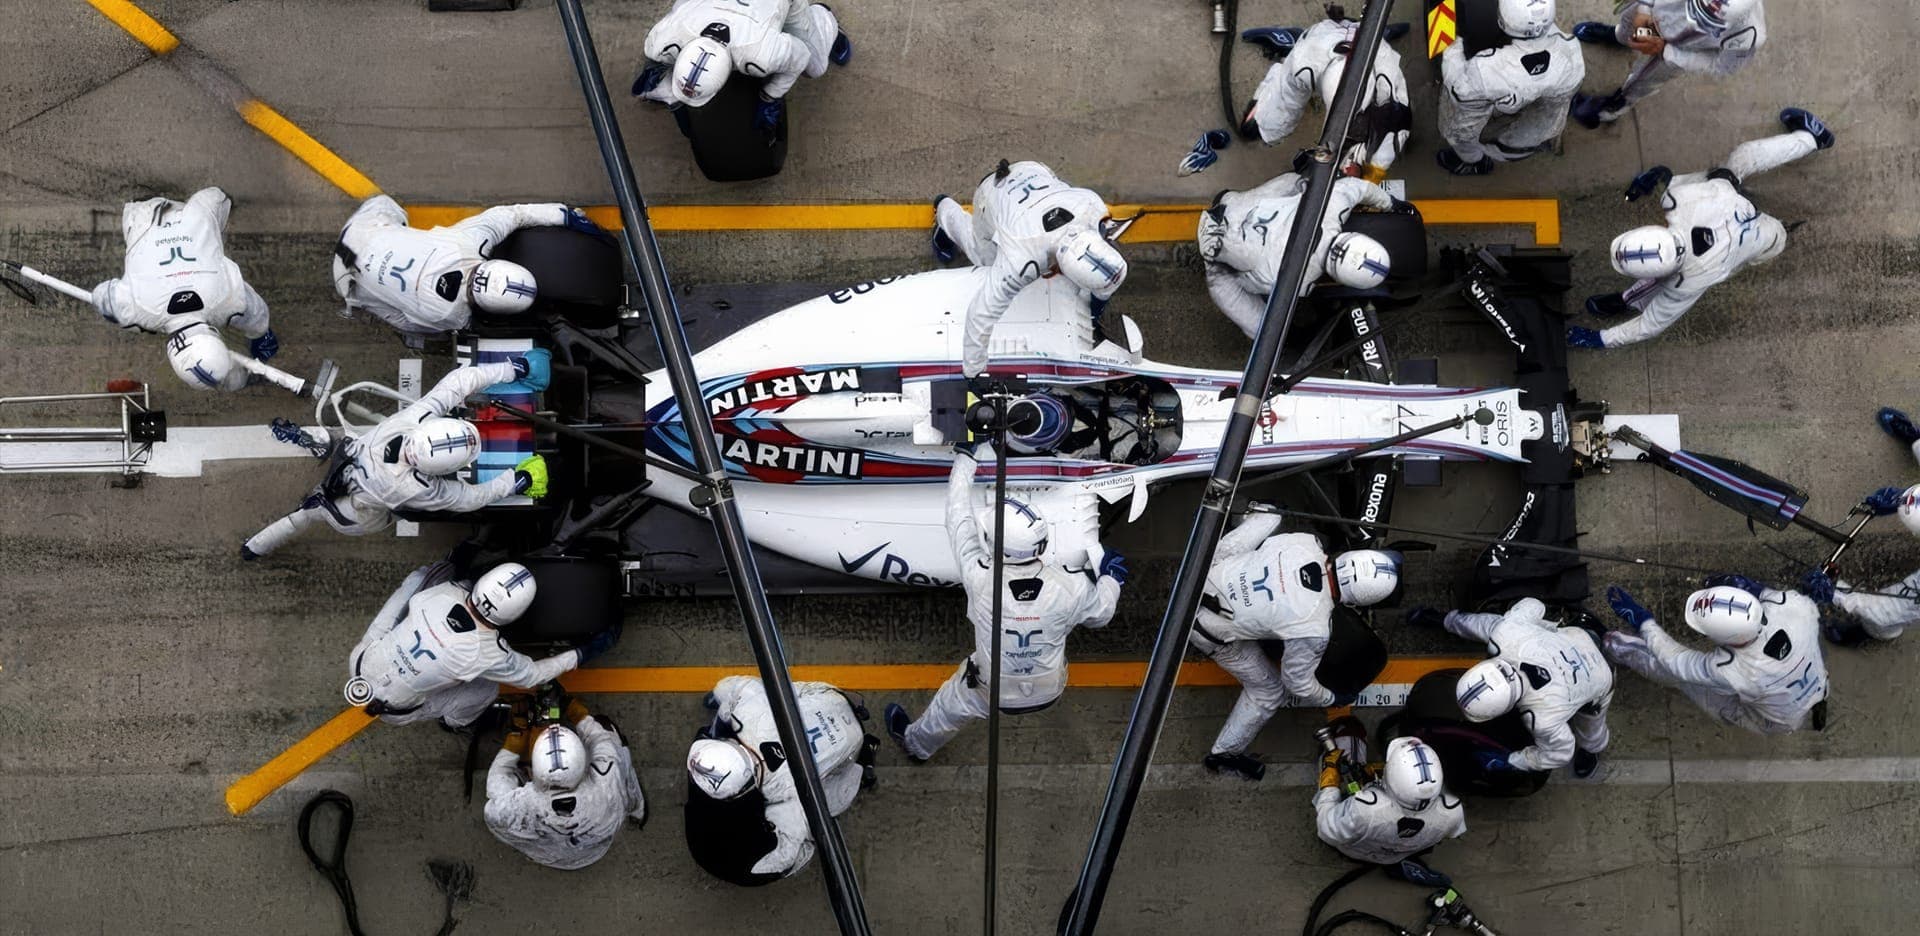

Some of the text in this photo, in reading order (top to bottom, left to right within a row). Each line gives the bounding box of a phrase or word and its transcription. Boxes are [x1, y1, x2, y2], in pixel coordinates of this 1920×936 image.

[1351, 306, 1380, 363] Reona
[710, 368, 861, 415] MARTIN
[1495, 400, 1509, 447] ORIS
